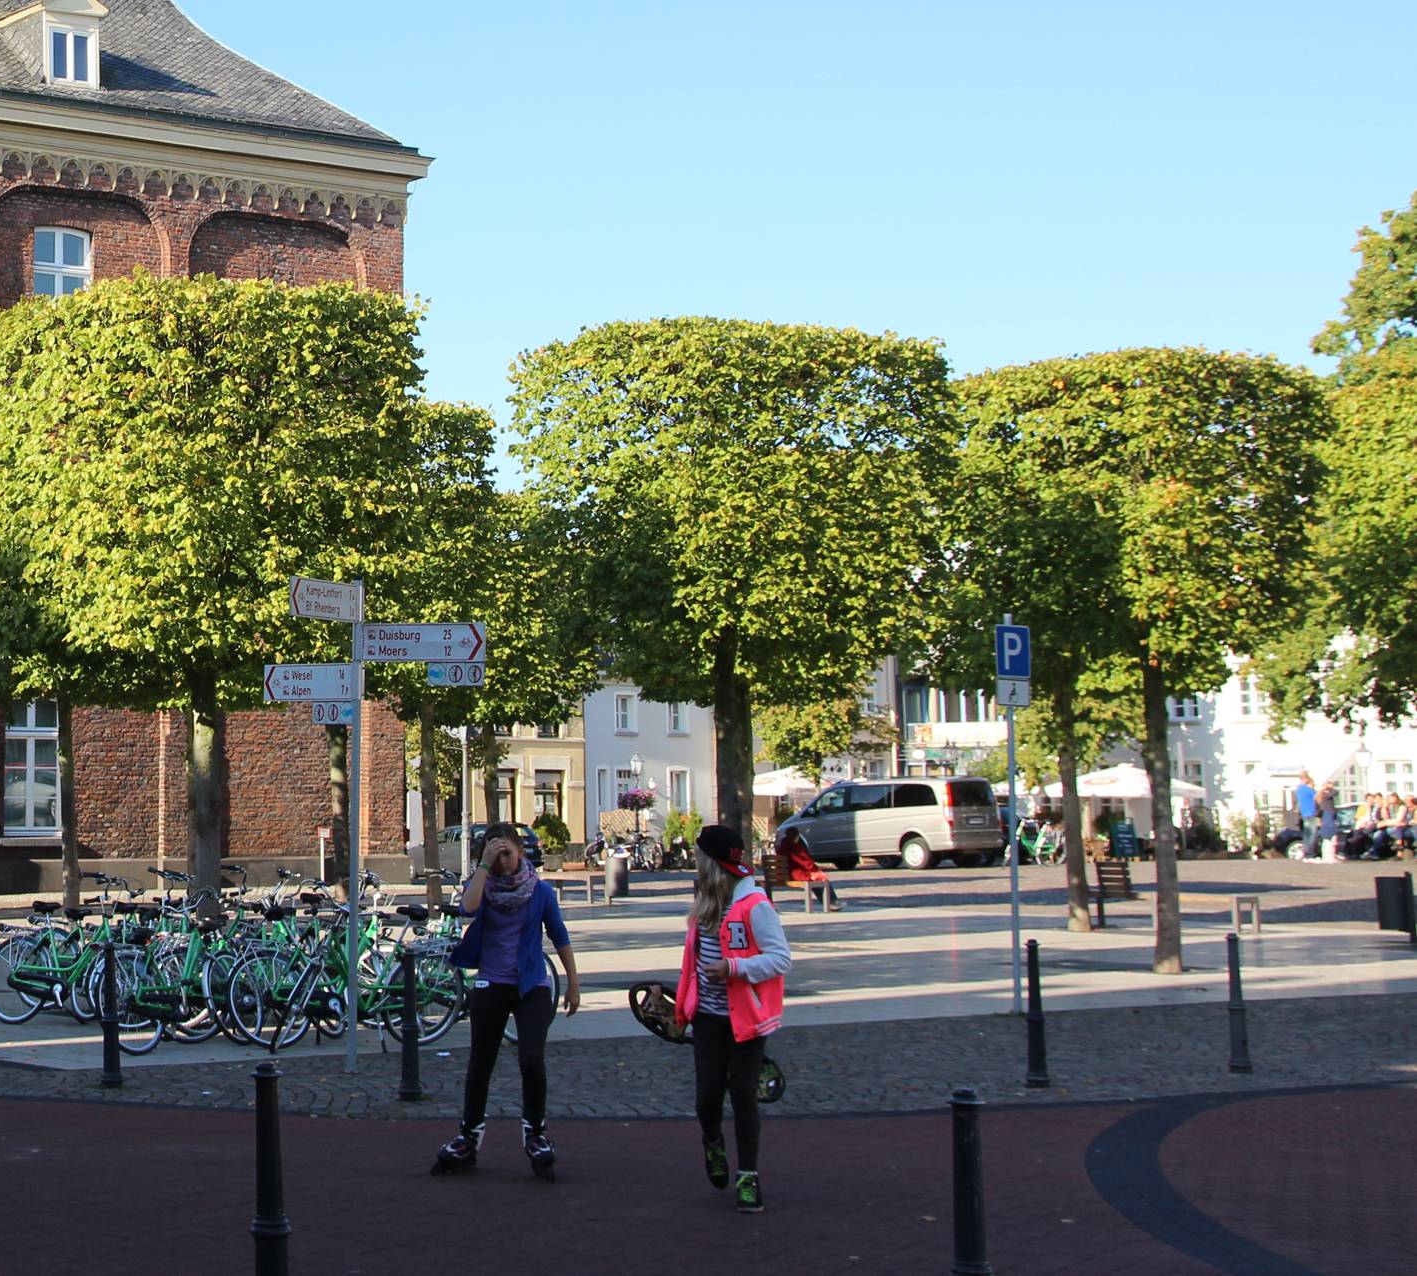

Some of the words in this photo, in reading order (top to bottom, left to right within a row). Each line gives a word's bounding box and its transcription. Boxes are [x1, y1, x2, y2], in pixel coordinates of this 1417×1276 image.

[306, 583, 342, 600] Kamp-Lintfort
[315, 601, 341, 617] Rheinberg
[379, 629, 421, 643] Duisburg
[443, 629, 452, 640] 25
[378, 646, 408, 656] Moers
[444, 646, 452, 657] 12
[1003, 632, 1022, 670] P
[291, 669, 313, 681] Wesel
[339, 669, 345, 680] 16
[291, 684, 312, 697] Alpen
[726, 921, 749, 951] R
